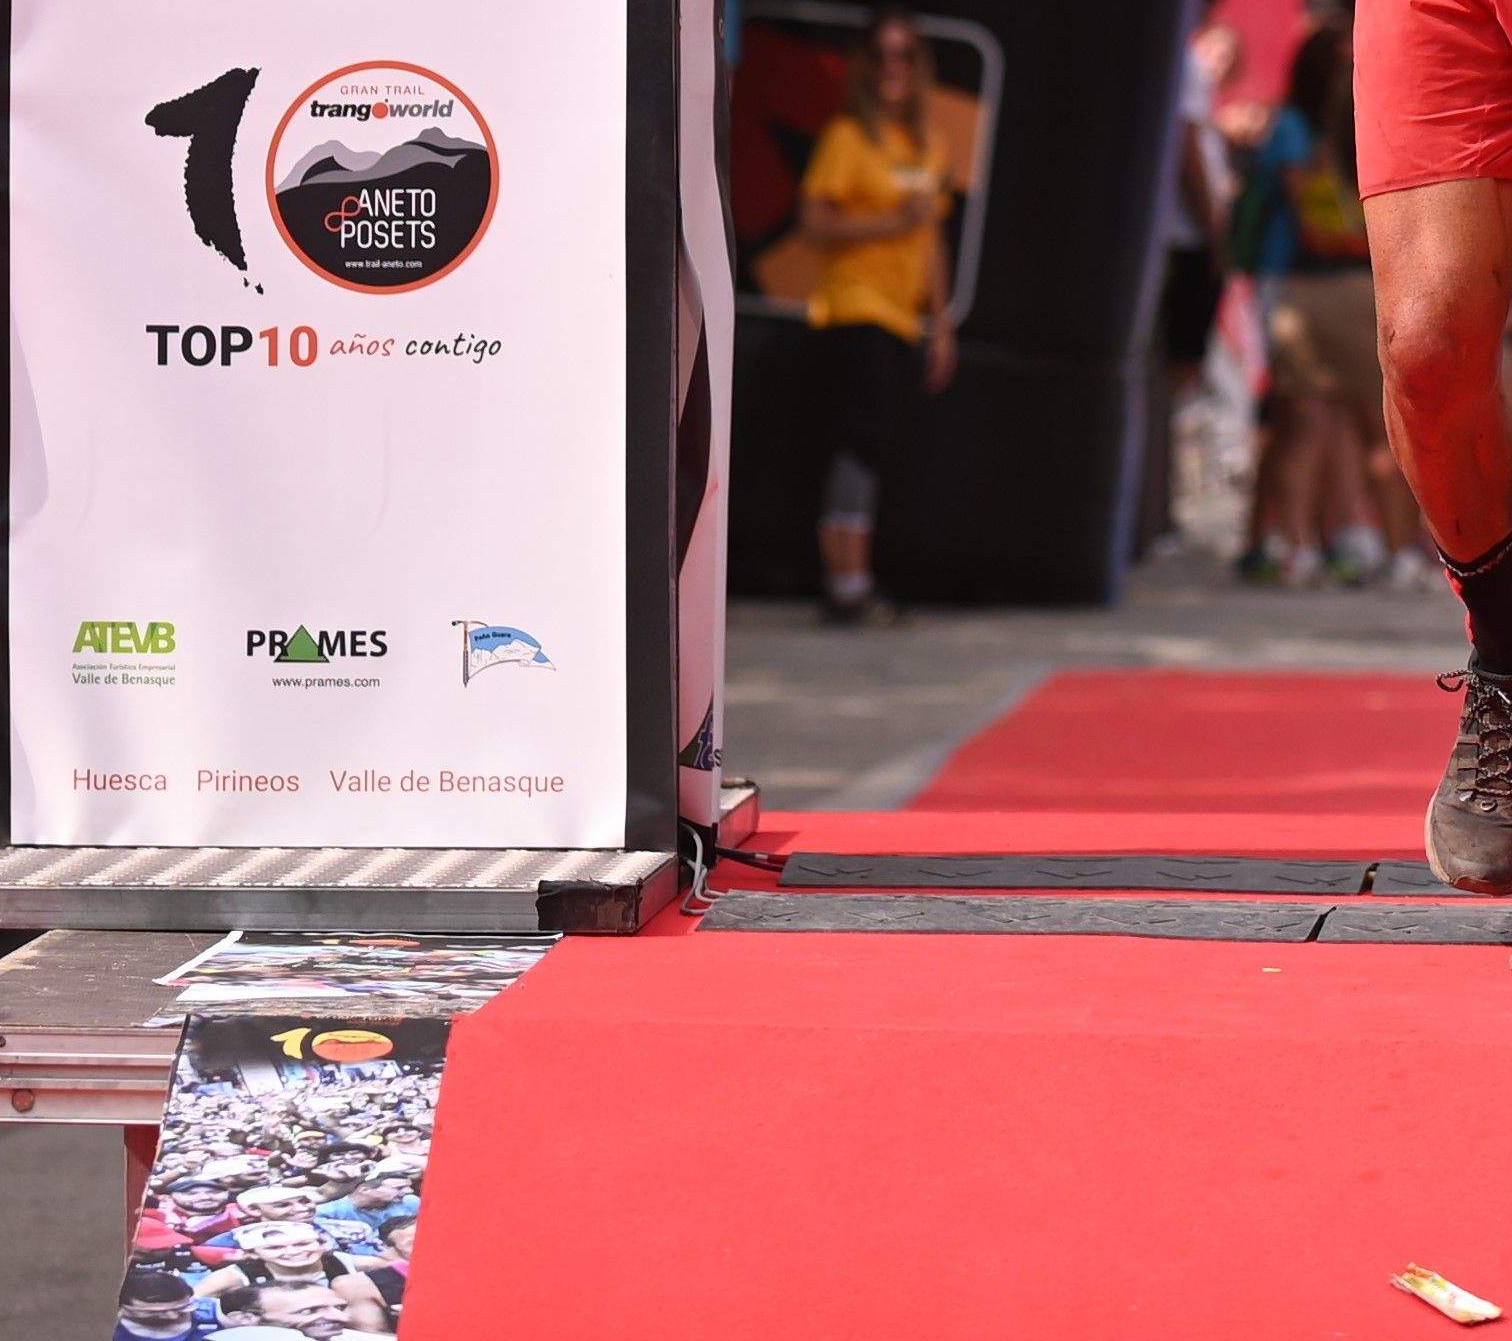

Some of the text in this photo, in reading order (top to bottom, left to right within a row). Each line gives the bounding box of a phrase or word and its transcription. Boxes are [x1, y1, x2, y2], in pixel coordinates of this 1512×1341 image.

[340, 85, 425, 95] GRAN TRAIL
[310, 98, 454, 122] trangoworld
[358, 188, 437, 217] ANETO
[341, 220, 436, 249] POSETS
[330, 333, 395, 357] años
[406, 332, 502, 363] contigo
[72, 621, 176, 654] ATEVB
[247, 625, 388, 662] PRAMES
[72, 673, 176, 688] Valle de Benasque
[272, 677, 380, 689] www.prames.com
[73, 768, 564, 798] Huesca Pirineos Valle de Benasque
